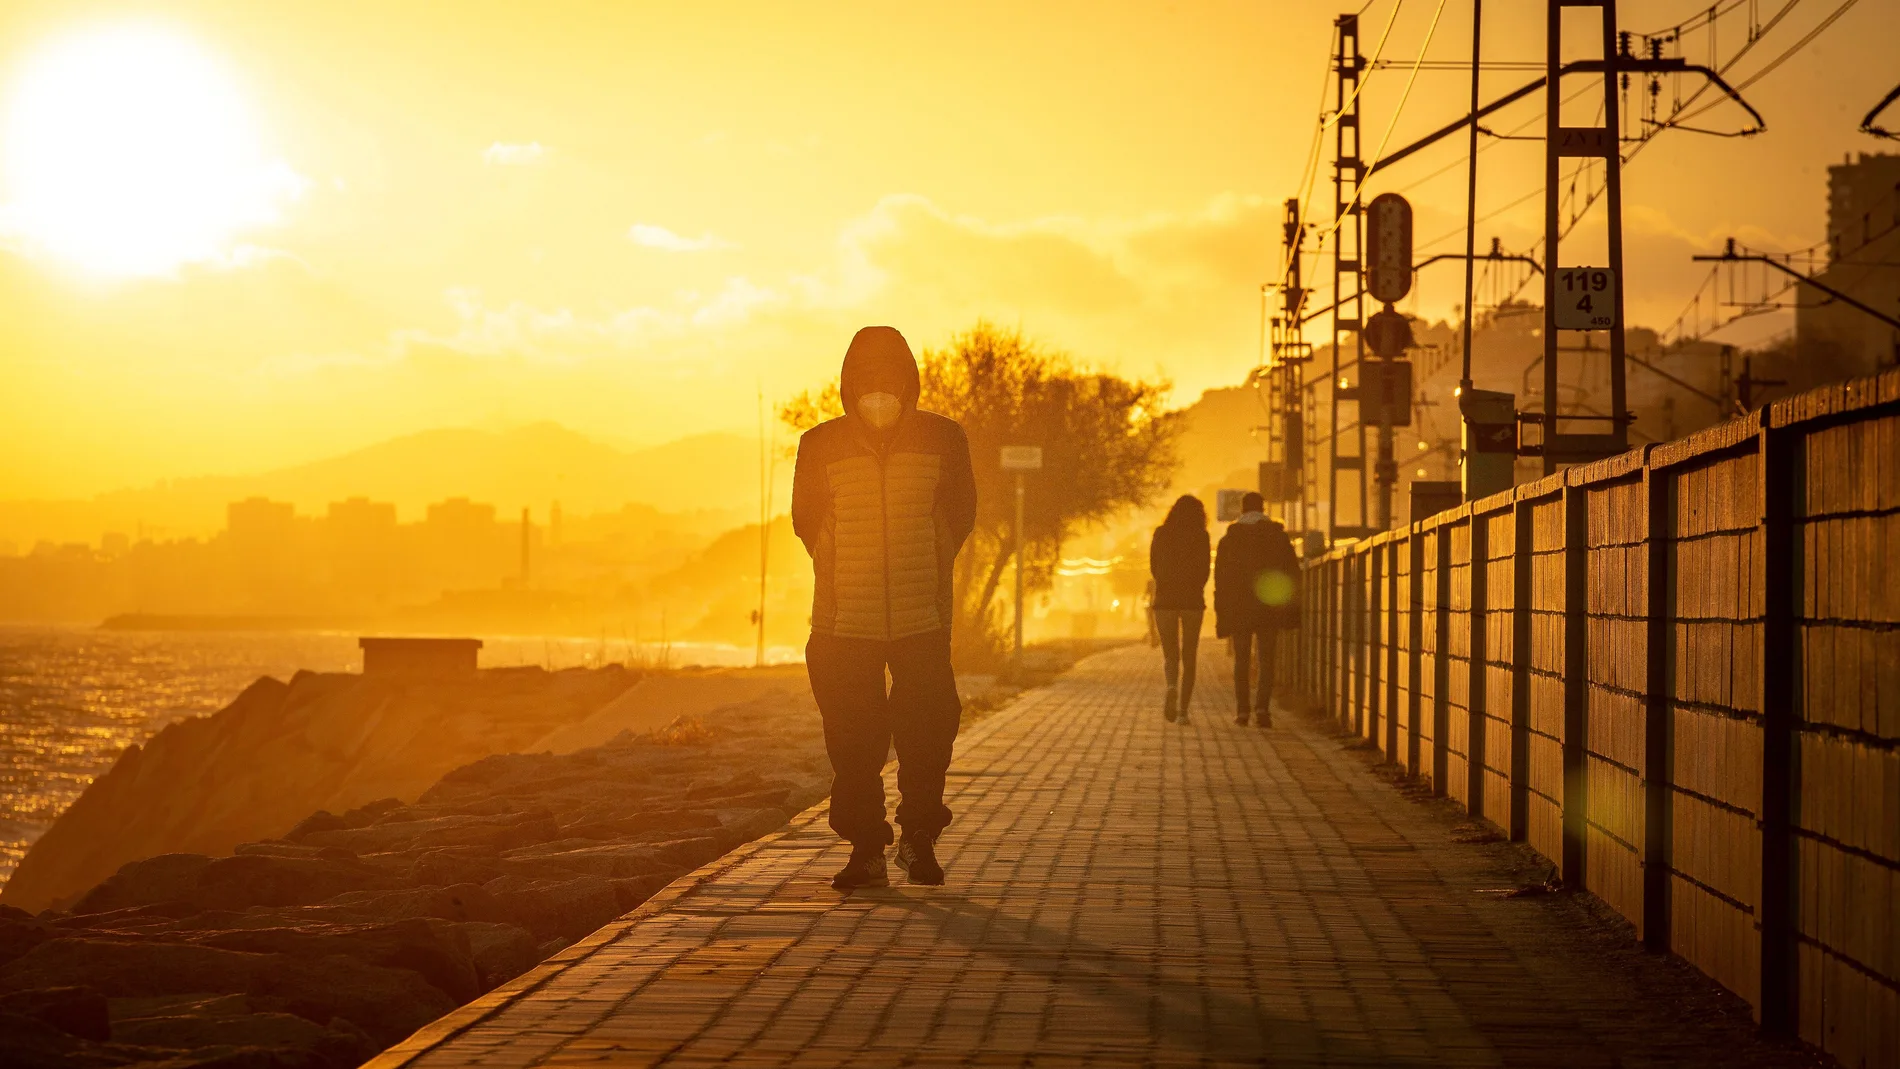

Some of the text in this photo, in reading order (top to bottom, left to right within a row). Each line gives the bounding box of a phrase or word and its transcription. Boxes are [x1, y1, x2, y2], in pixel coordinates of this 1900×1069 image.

[1562, 271, 1607, 291] 119
[1576, 294, 1593, 314] 4
[1590, 316, 1611, 326] 450
